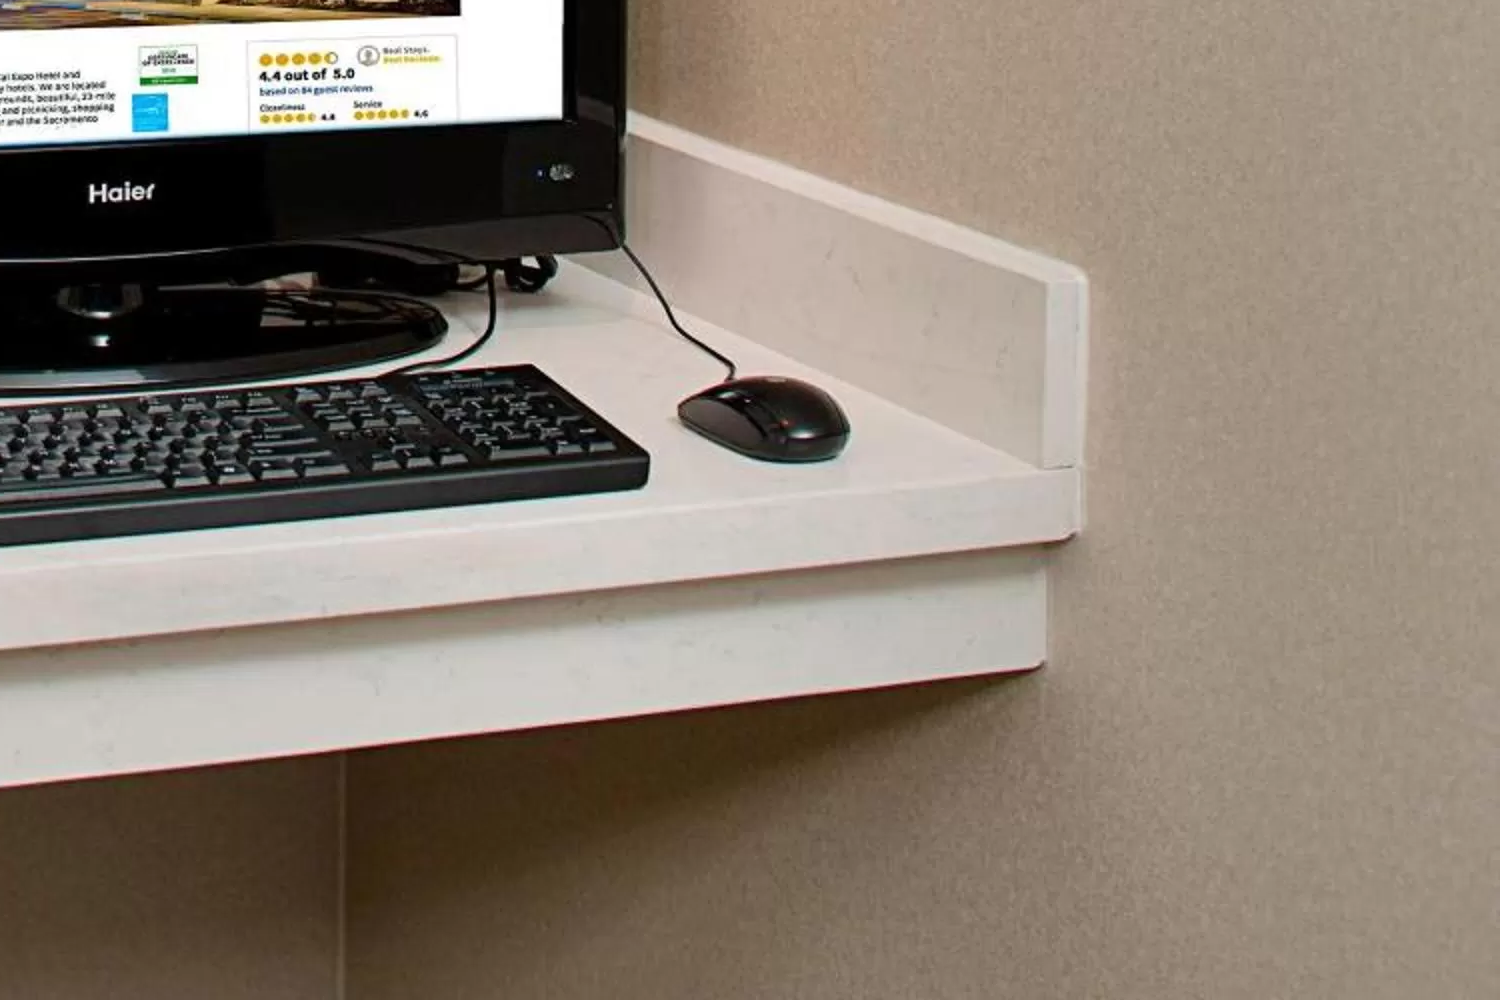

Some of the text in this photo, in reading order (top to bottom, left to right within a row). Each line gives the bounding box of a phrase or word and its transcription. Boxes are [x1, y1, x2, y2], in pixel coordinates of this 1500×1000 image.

[259, 68, 355, 82] 4.4 out of 5.0
[89, 181, 155, 204] Haier
